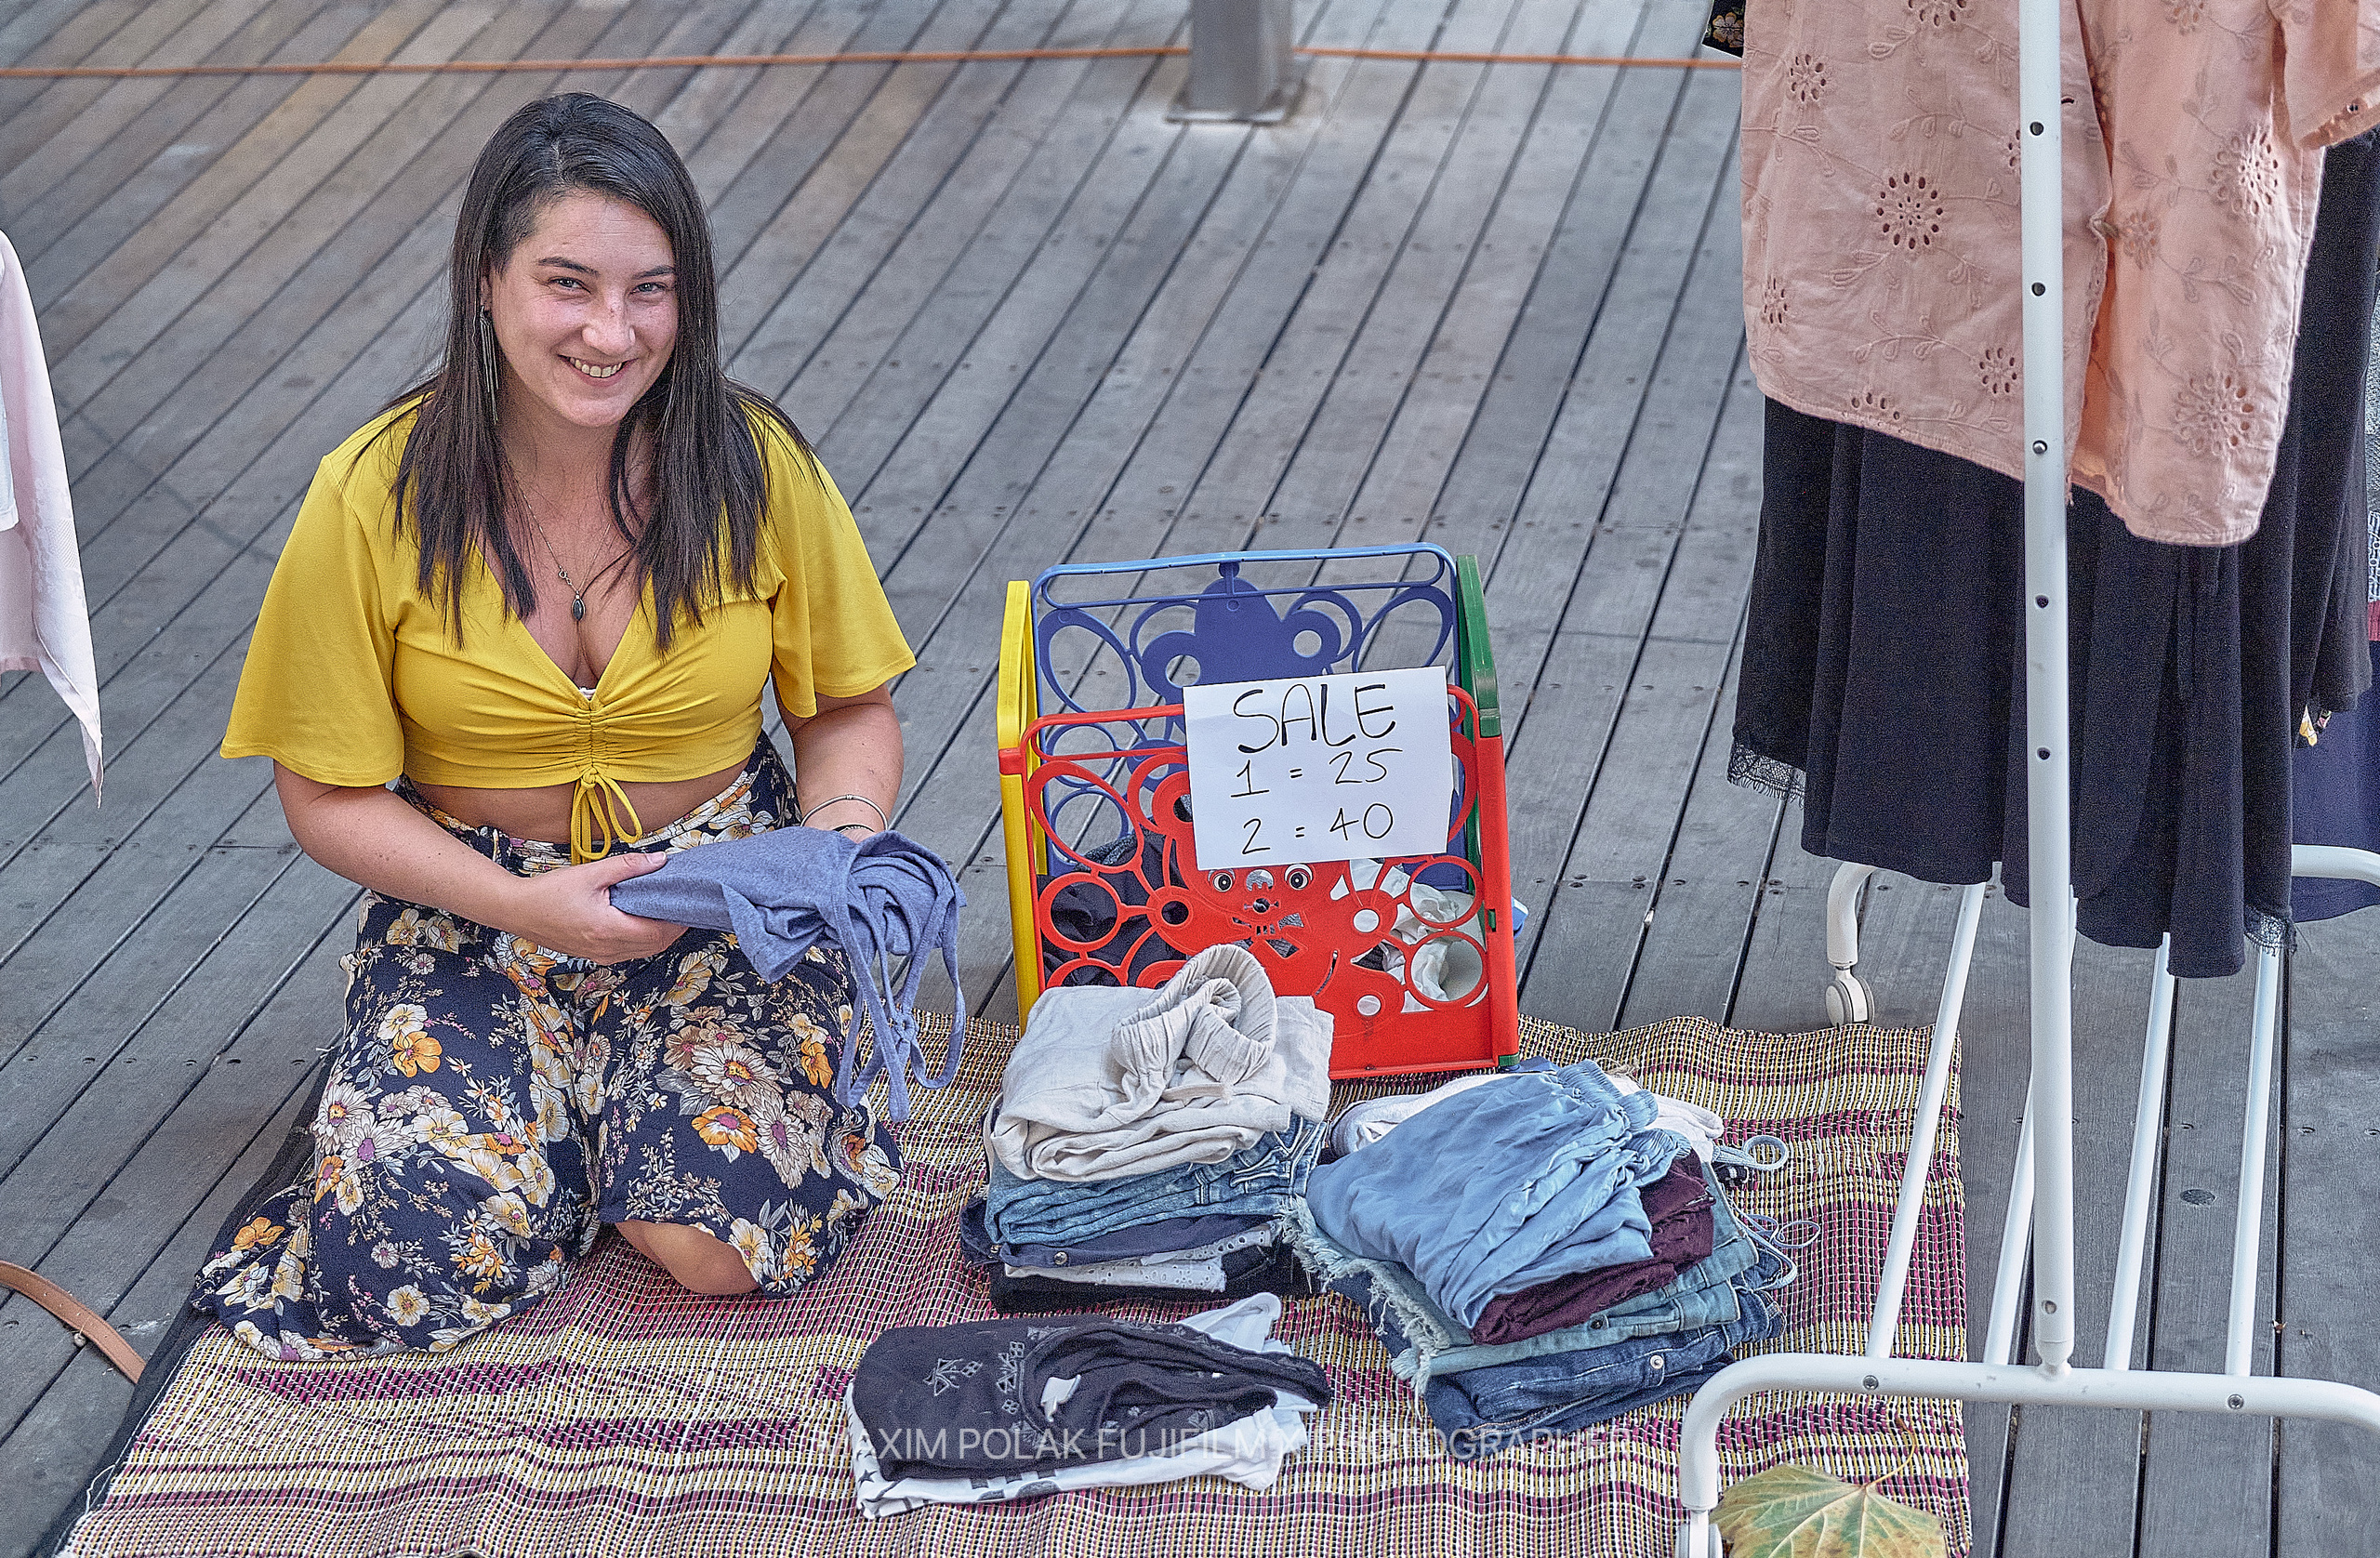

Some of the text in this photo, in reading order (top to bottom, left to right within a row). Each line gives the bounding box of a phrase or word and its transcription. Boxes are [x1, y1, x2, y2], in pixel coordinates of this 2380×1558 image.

[1233, 683, 1396, 754] SALE
[1230, 759, 1270, 798] 1
[1329, 747, 1404, 785] 25
[1241, 818, 1271, 855] 2
[1329, 802, 1394, 841] 40
